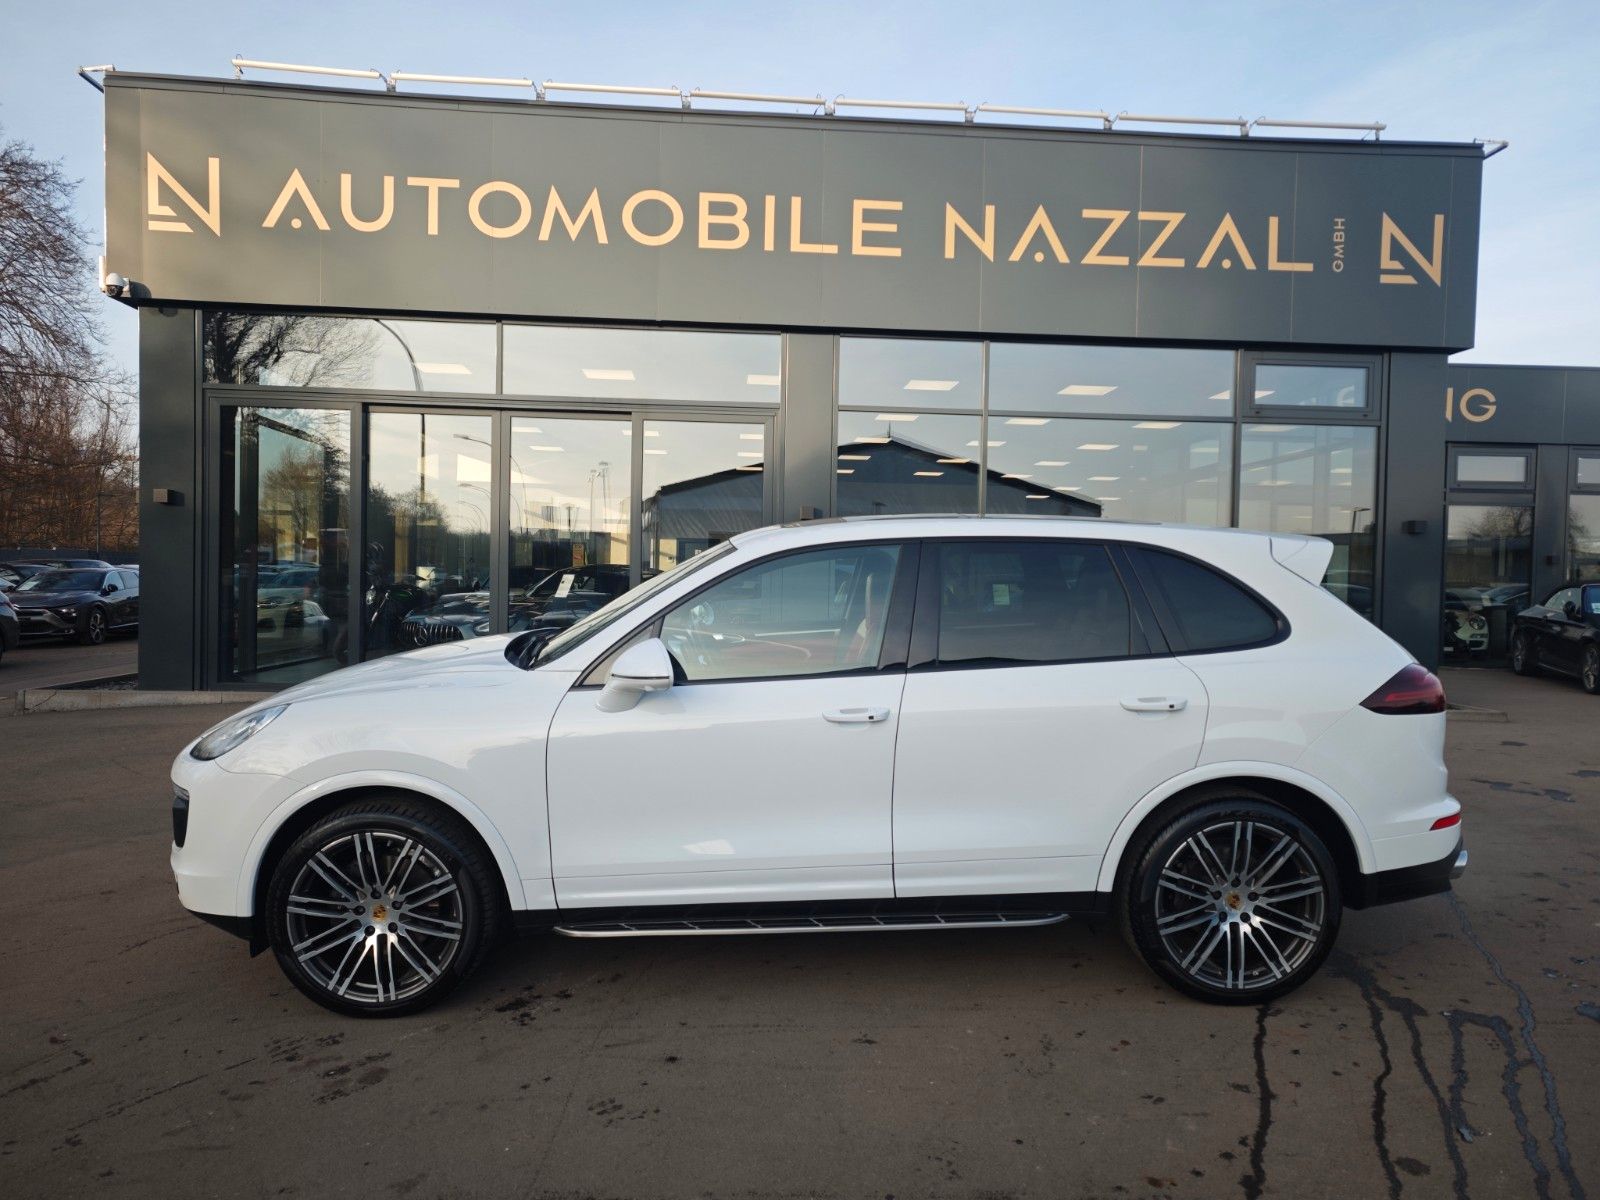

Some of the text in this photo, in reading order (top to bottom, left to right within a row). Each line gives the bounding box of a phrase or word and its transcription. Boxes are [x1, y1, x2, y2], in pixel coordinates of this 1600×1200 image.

[262, 167, 1313, 271] AUTOMOBILE NAZZAL
[1332, 218, 1345, 273] GMBH
